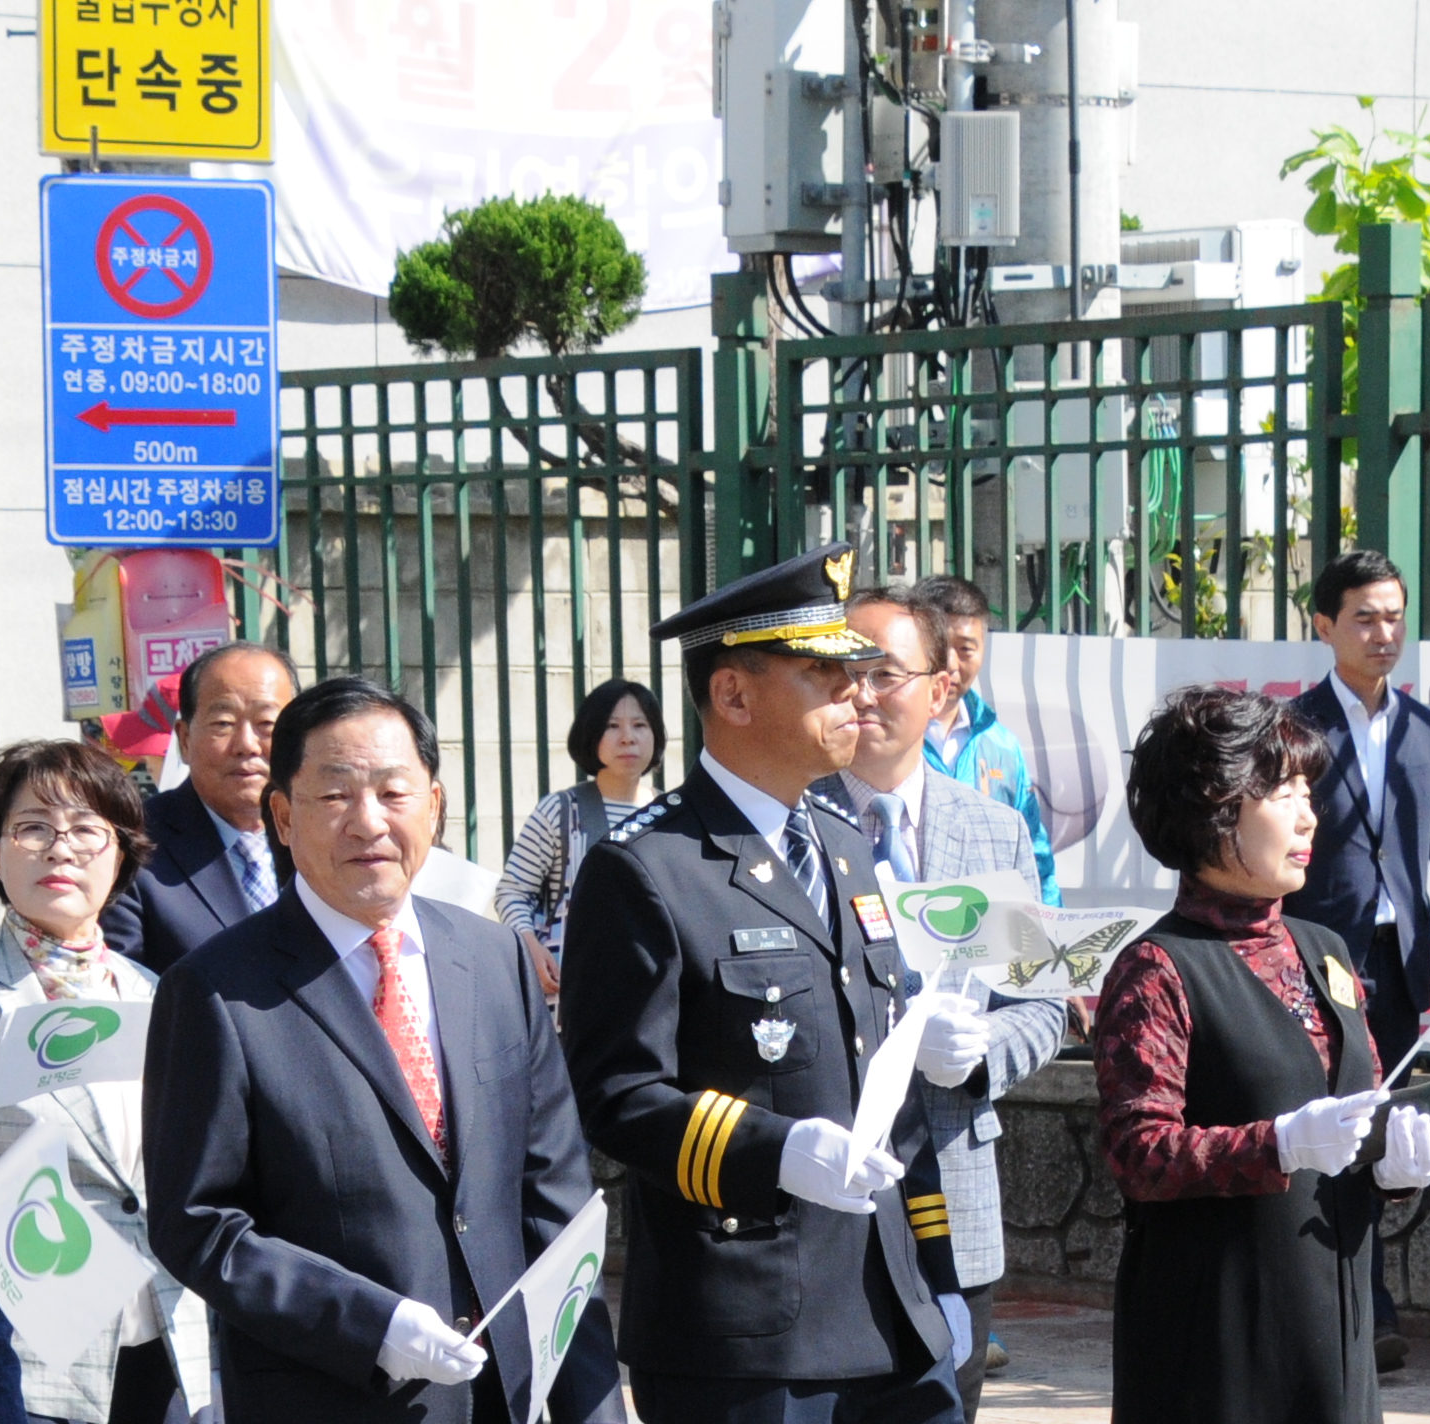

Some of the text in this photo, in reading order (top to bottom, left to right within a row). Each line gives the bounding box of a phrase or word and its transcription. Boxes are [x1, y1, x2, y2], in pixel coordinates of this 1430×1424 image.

[75, 47, 243, 115] 단속중
[111, 247, 199, 268] 주정차금지
[60, 333, 266, 367] 주정차금지시간
[120, 371, 261, 396] 09:00~18:00
[133, 441, 198, 463] 500m
[62, 477, 267, 506] 점심시간 주정차허용
[102, 509, 238, 532] 12:00~13:30
[37, 1068, 82, 1088] 함평군
